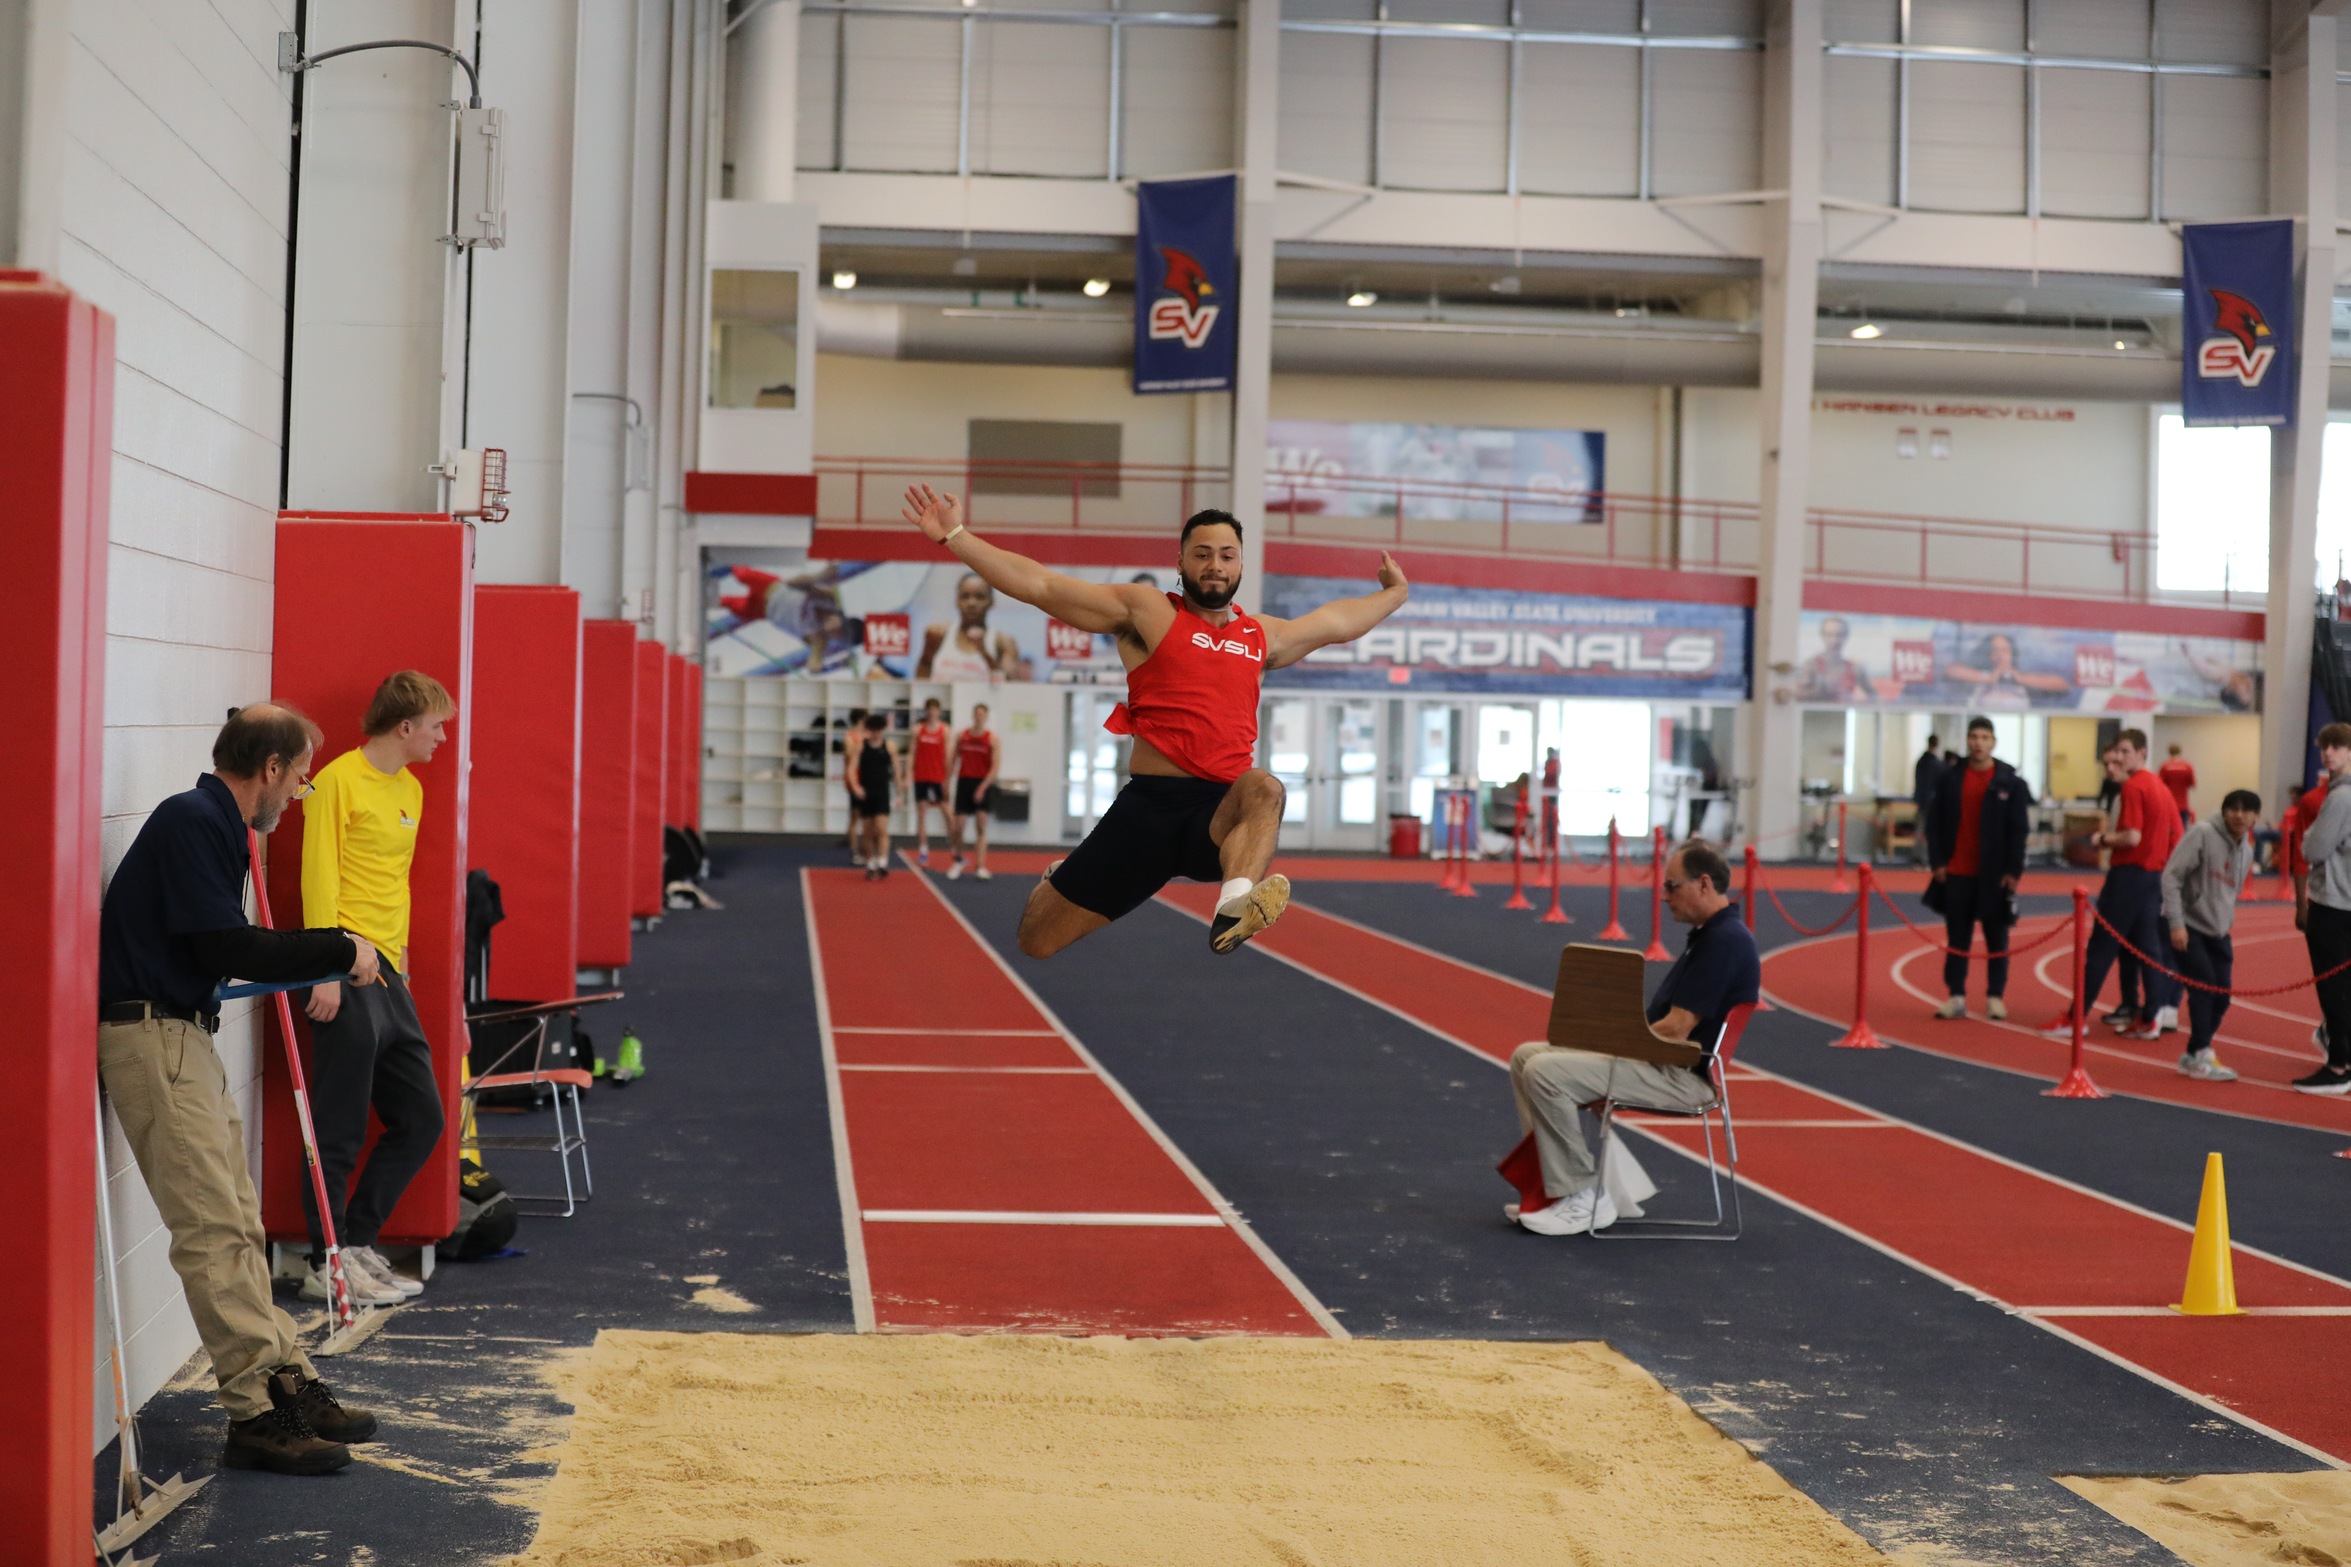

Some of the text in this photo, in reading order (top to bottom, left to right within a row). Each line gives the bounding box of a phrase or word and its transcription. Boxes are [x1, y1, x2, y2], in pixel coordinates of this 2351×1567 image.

[1150, 298, 1219, 348] SV
[2199, 338, 2276, 387] SV
[1922, 405, 2012, 417] LEGACY
[2016, 408, 2075, 421] CLUB
[866, 621, 908, 646] We
[1192, 632, 1262, 662] SVSU
